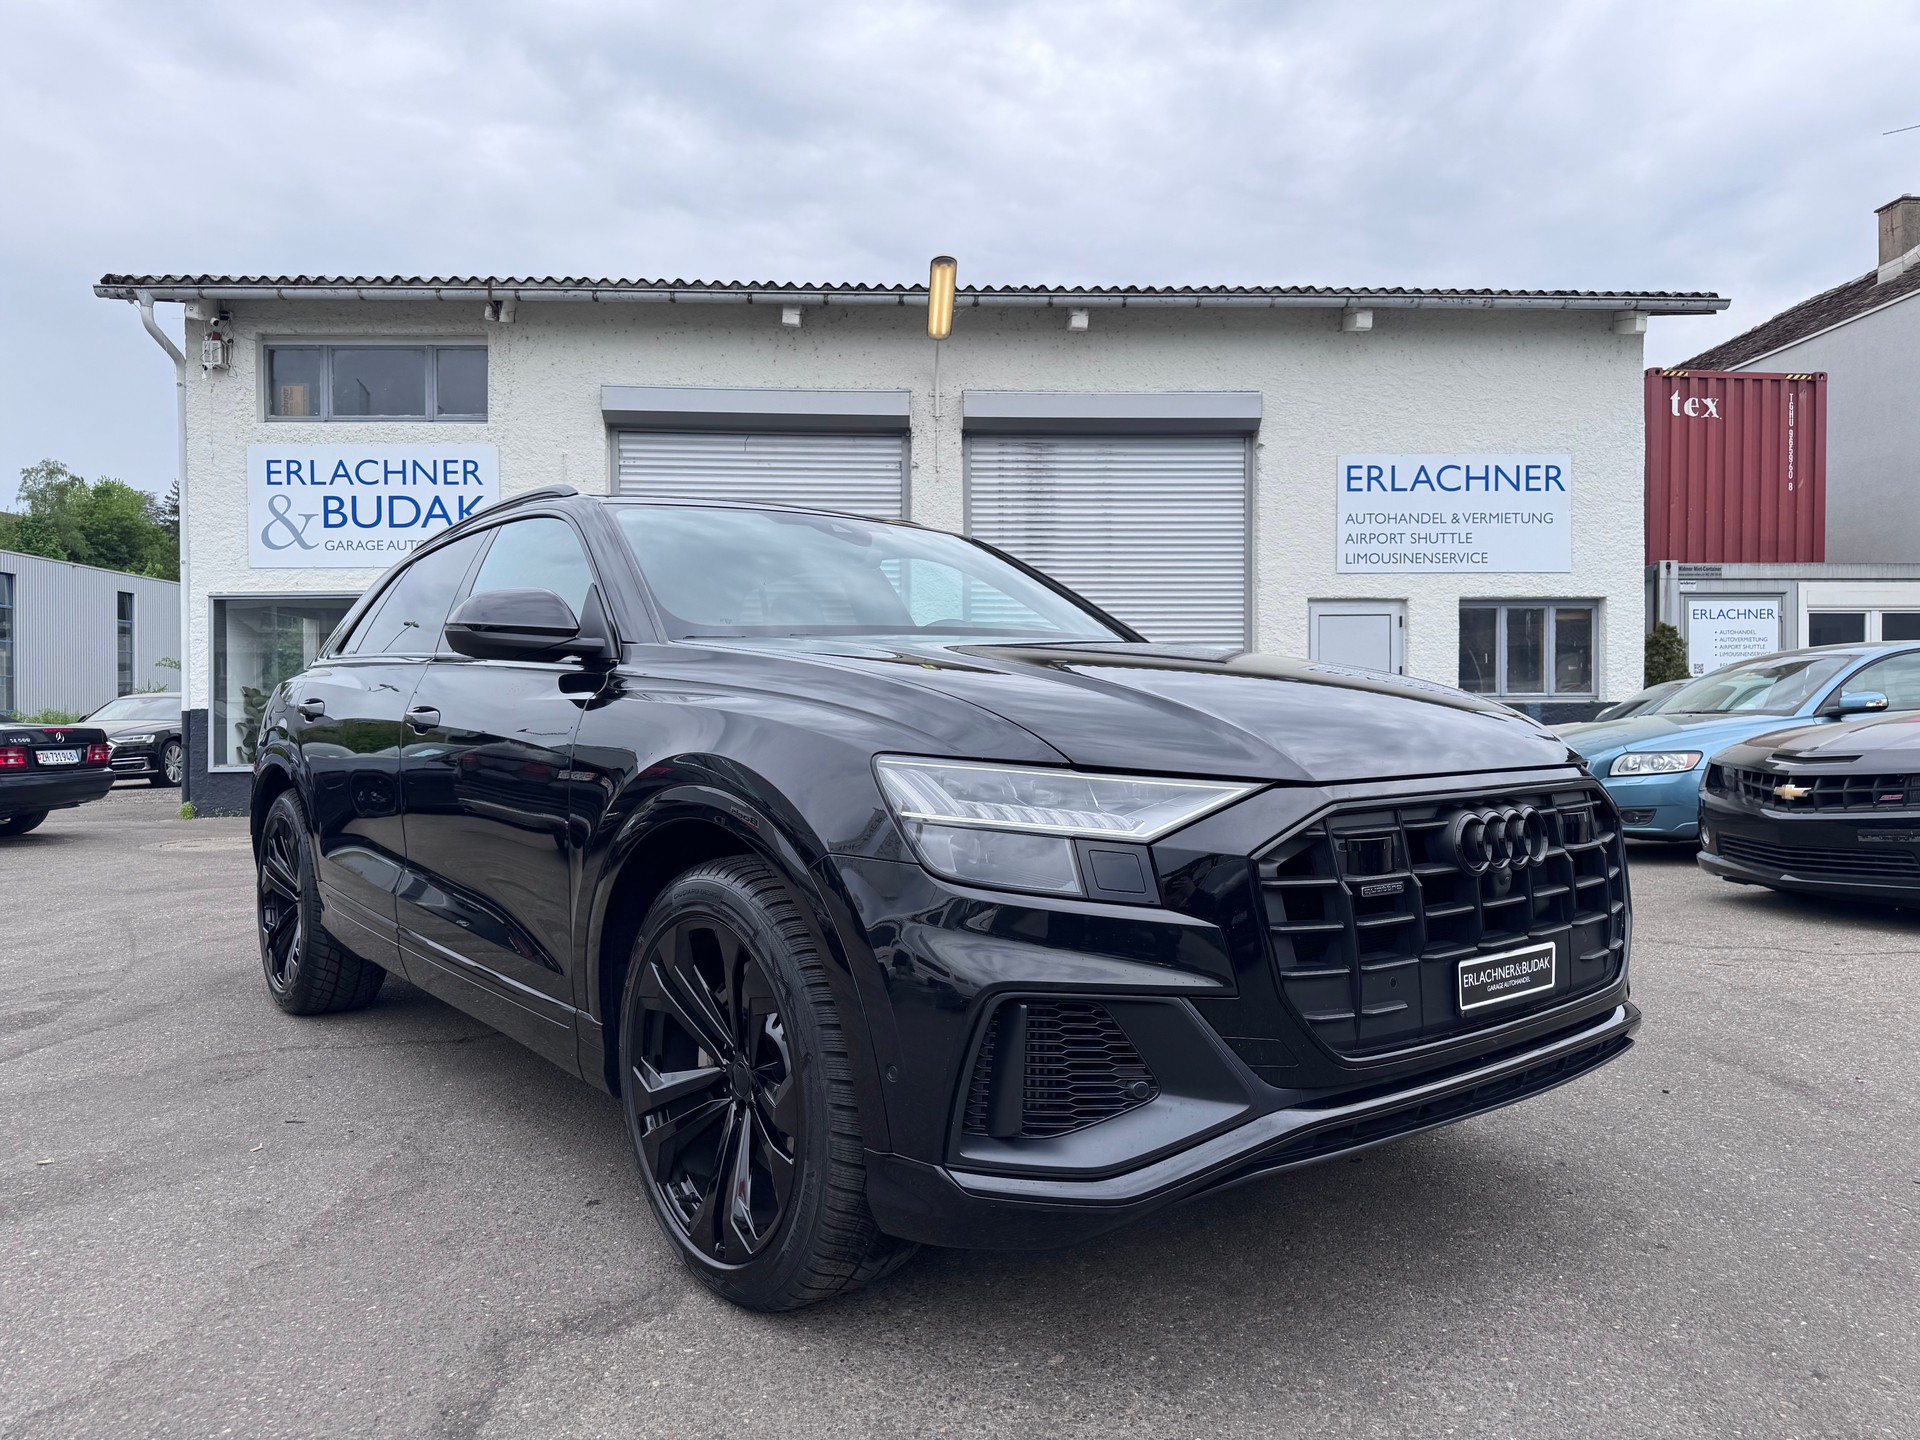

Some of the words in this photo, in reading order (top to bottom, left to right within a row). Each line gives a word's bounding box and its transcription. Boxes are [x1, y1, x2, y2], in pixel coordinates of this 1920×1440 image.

[1670, 389, 1720, 419] tex
[266, 459, 484, 486] ERLACHNER
[1346, 464, 1566, 492] ERLACHNER
[260, 493, 319, 551] &
[1345, 512, 1447, 525] AUTOHANDEL
[1451, 512, 1460, 525] &
[1462, 512, 1554, 525] VERMIETUNG
[1345, 532, 1406, 545] AIRPORT
[1410, 532, 1473, 545] SHUTTLE
[324, 539, 384, 552] GARAGE
[1345, 552, 1489, 565] LIMOUSINENSERVICE
[1692, 608, 1775, 620] ERLACHNER
